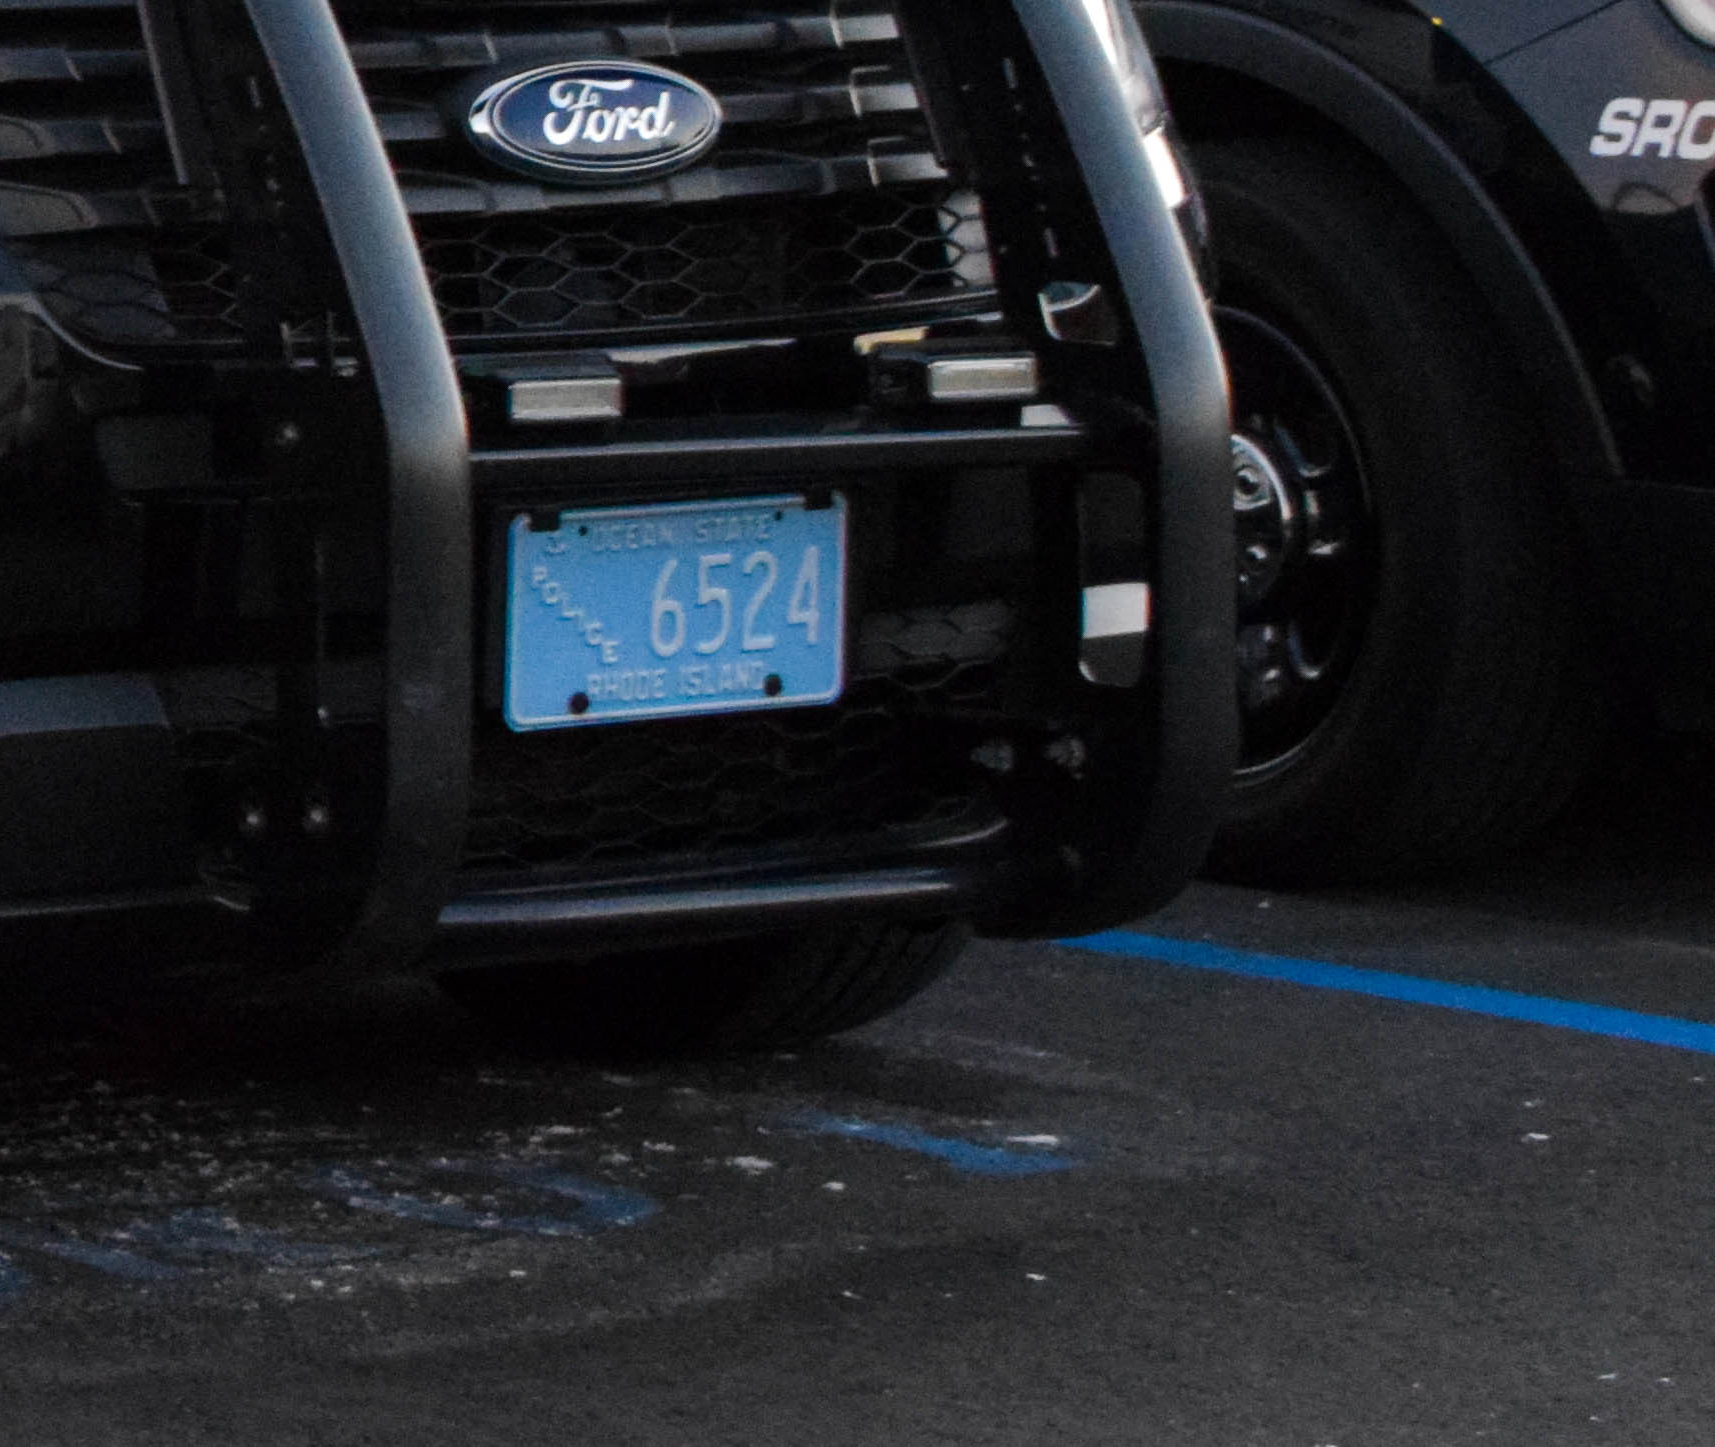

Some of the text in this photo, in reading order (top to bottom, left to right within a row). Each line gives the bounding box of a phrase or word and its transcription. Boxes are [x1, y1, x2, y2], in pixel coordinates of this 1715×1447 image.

[543, 78, 674, 147] Ford
[1589, 97, 1715, 159] SRO
[695, 512, 772, 543] STATE
[649, 545, 821, 659] 6524
[585, 660, 765, 701] RHODE ISLAND
